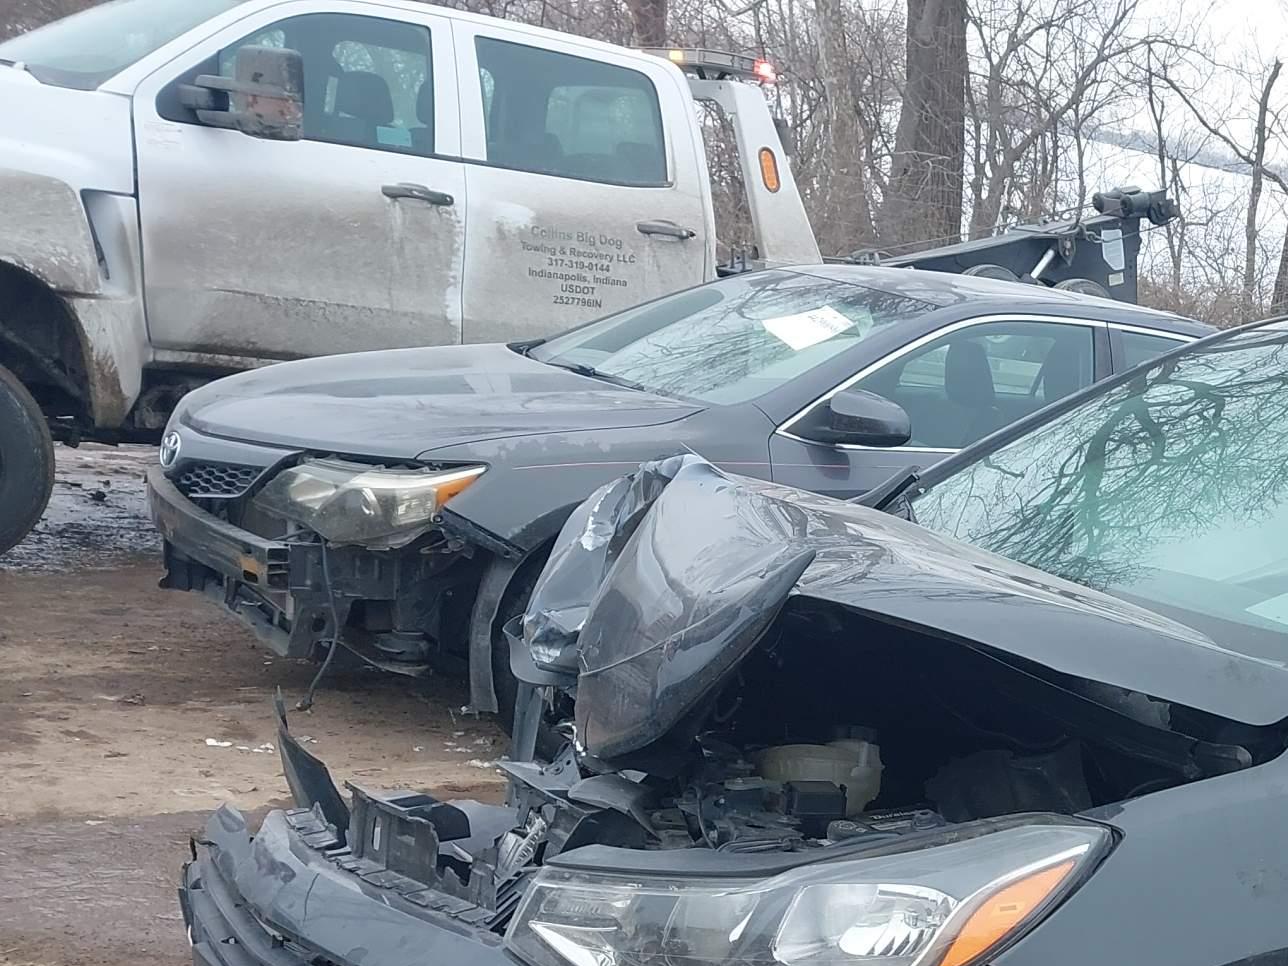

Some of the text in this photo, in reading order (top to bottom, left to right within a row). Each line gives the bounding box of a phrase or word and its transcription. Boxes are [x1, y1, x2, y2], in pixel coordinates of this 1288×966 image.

[531, 226, 623, 249] Collins Big Dog
[521, 241, 636, 264] Towing & Recovery LLC
[547, 257, 611, 273] 317-319-0144
[528, 267, 628, 287] Indianapolis, Indiana
[561, 284, 596, 295] USDOT
